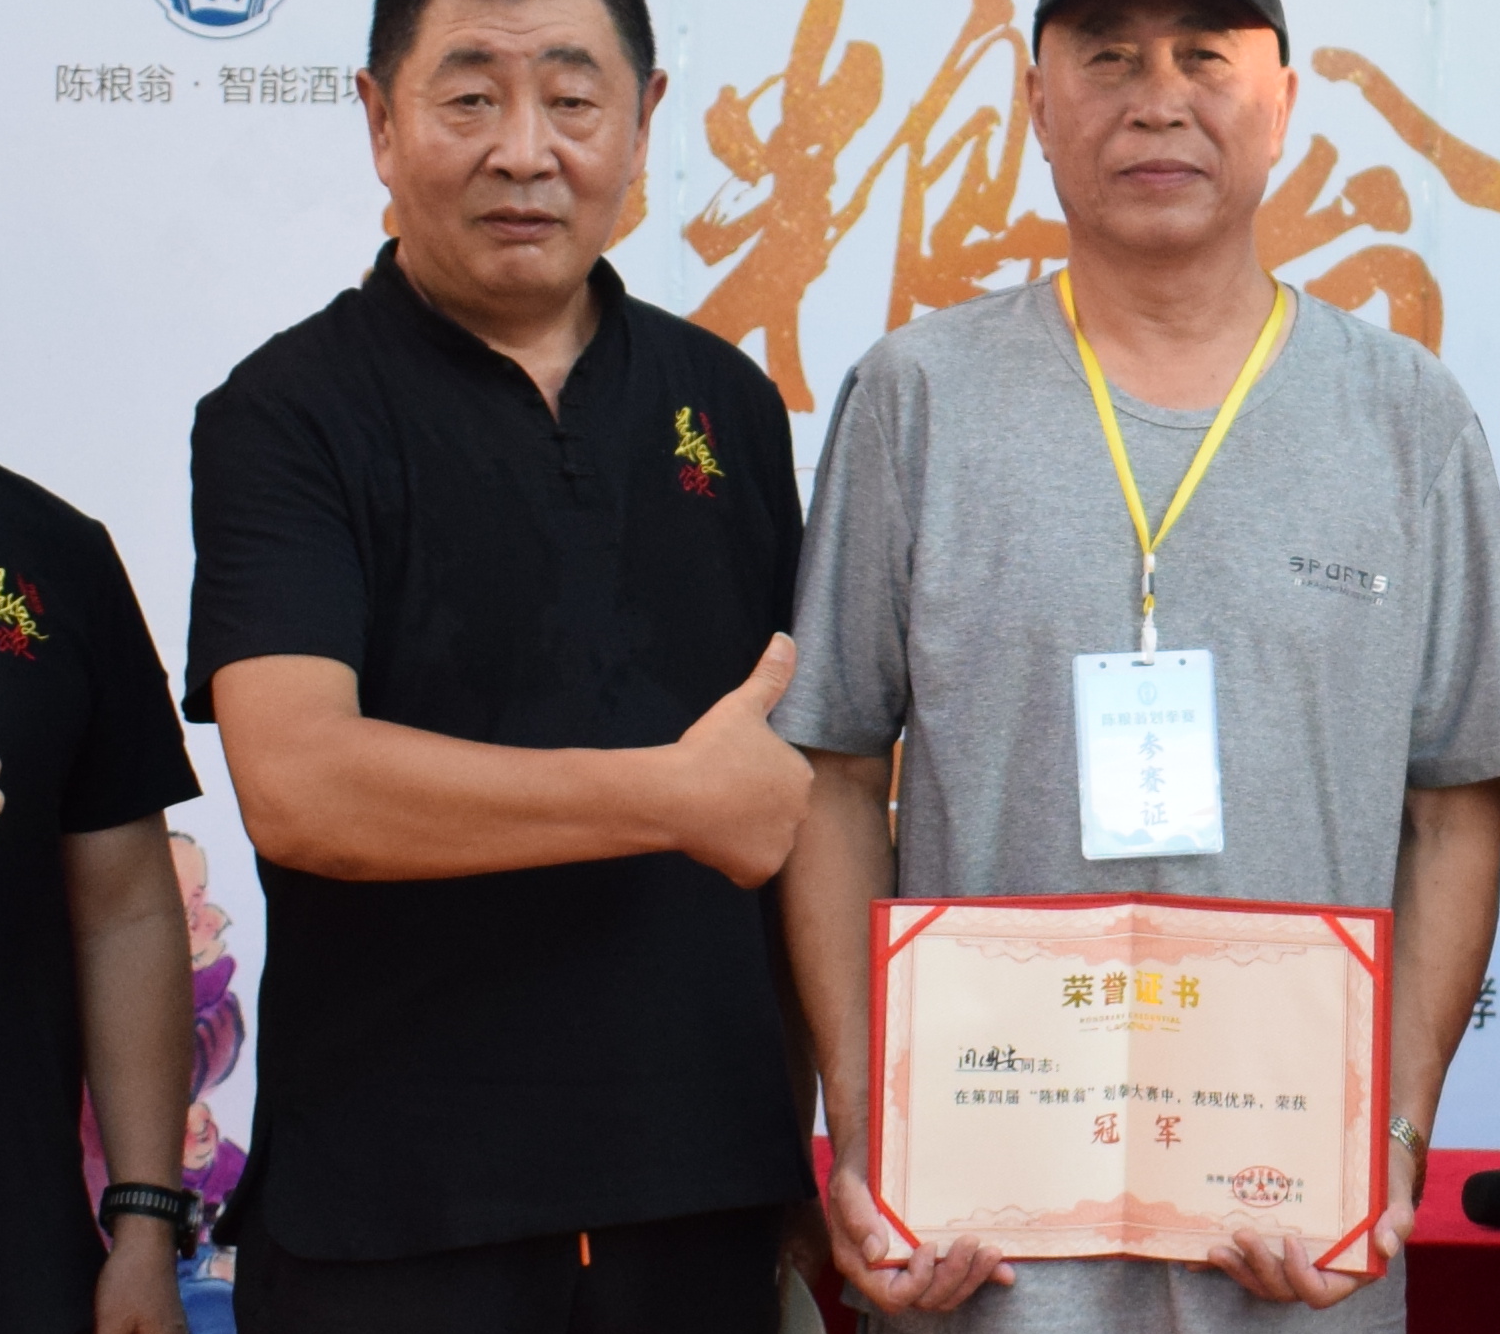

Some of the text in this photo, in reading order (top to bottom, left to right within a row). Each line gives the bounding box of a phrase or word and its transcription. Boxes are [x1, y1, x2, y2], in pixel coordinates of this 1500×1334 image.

[1288, 555, 1389, 593] SPORTS
[1138, 731, 1170, 827] 参赛证
[1062, 970, 1201, 1009] 荣誉证书
[1090, 1112, 1183, 1150] 冠军
